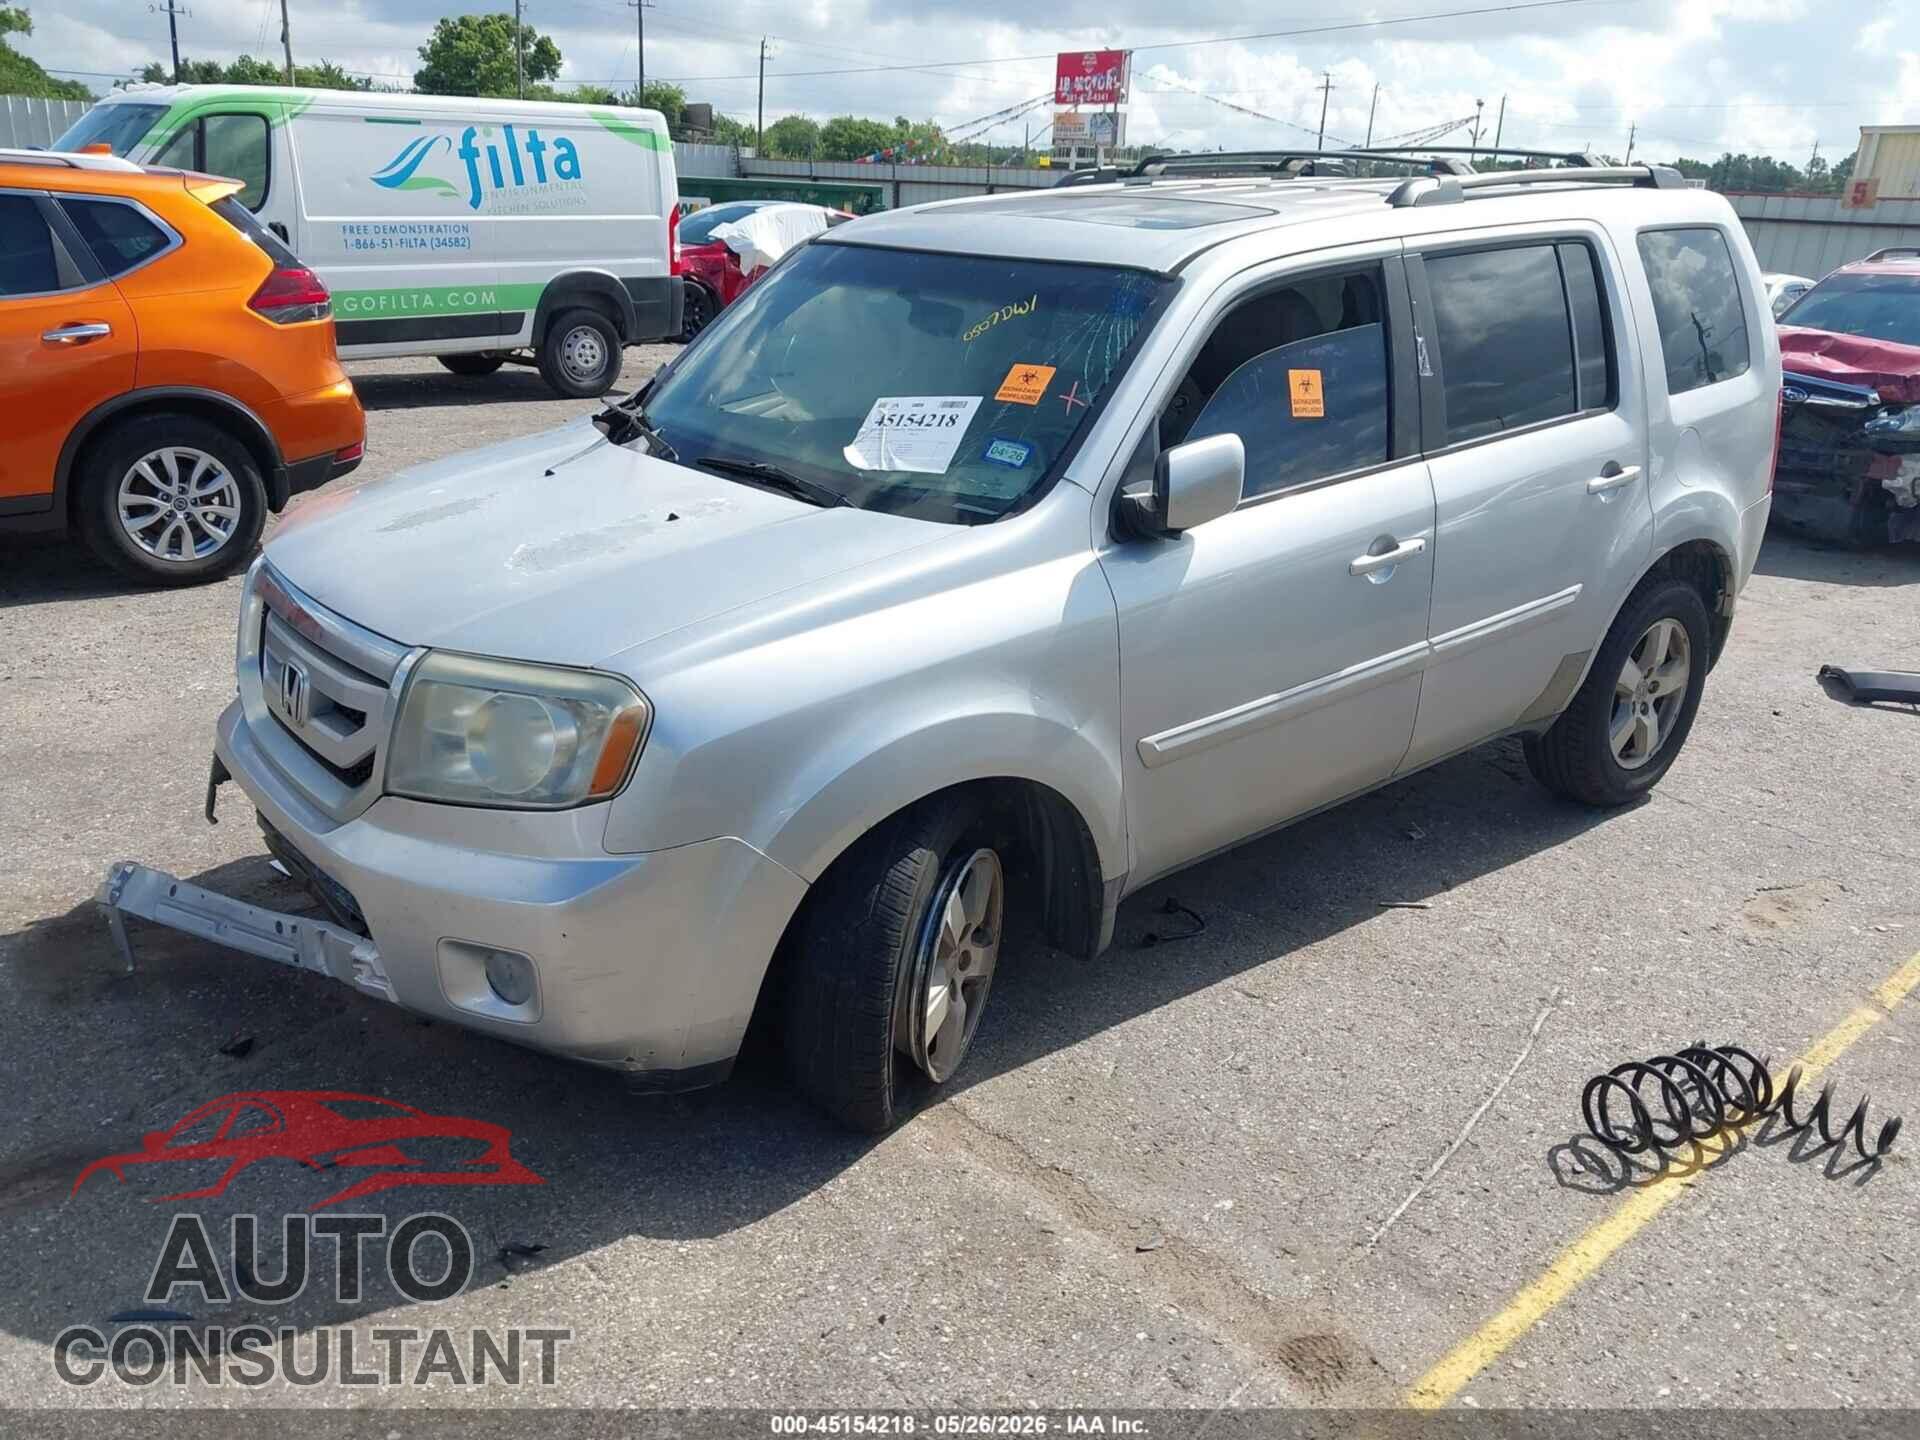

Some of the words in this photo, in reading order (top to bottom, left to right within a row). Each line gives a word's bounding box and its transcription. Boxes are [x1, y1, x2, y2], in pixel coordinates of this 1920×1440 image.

[458, 124, 582, 210] filta
[1851, 182, 1868, 205] 5
[342, 224, 369, 235] FREE
[374, 223, 469, 234] DEMONSTRATION
[343, 238, 427, 249] 1-866-51-FILTA
[430, 236, 471, 250] (34582)
[875, 413, 960, 428] 45154218
